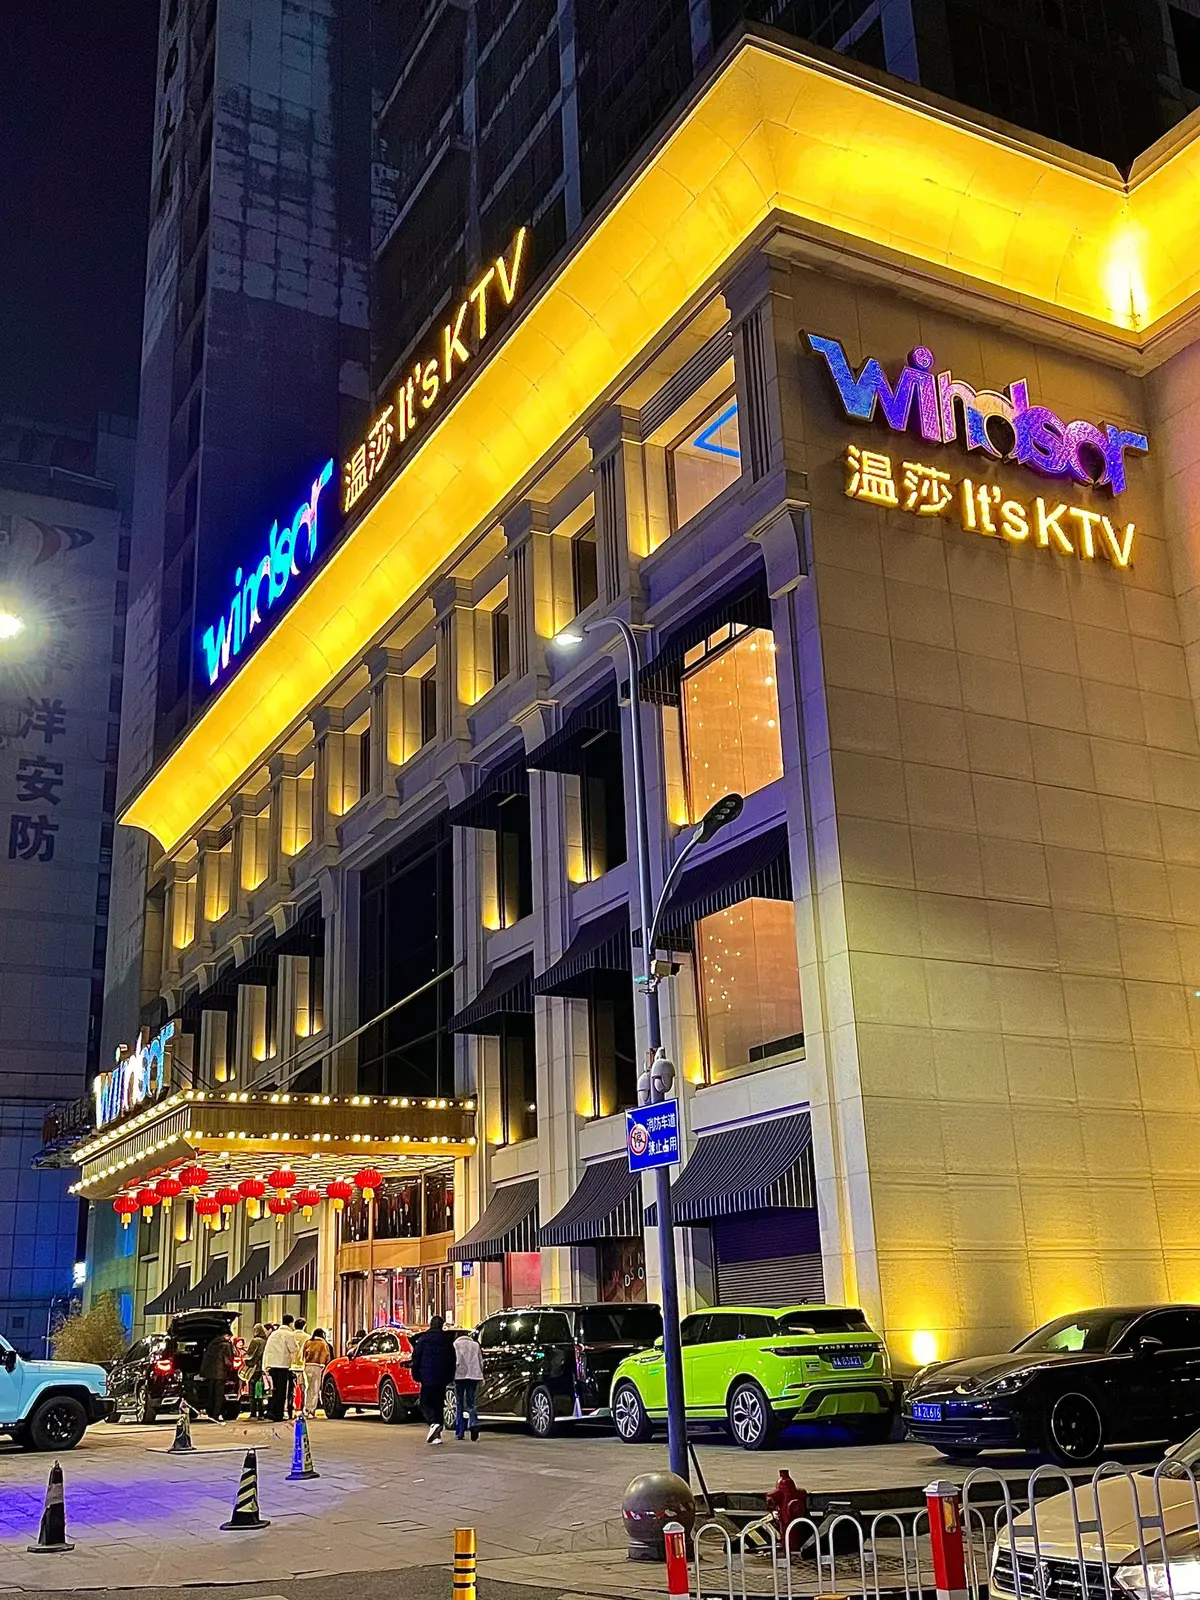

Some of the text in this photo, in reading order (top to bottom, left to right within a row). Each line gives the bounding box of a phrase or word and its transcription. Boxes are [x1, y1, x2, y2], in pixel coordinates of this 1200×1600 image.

[343, 226, 527, 512] 温莎 It's KTV
[844, 444, 1136, 567] 温莎 It's KTV
[646, 1113, 676, 1132] 消防车道
[648, 1136, 677, 1156] 禁止占用
